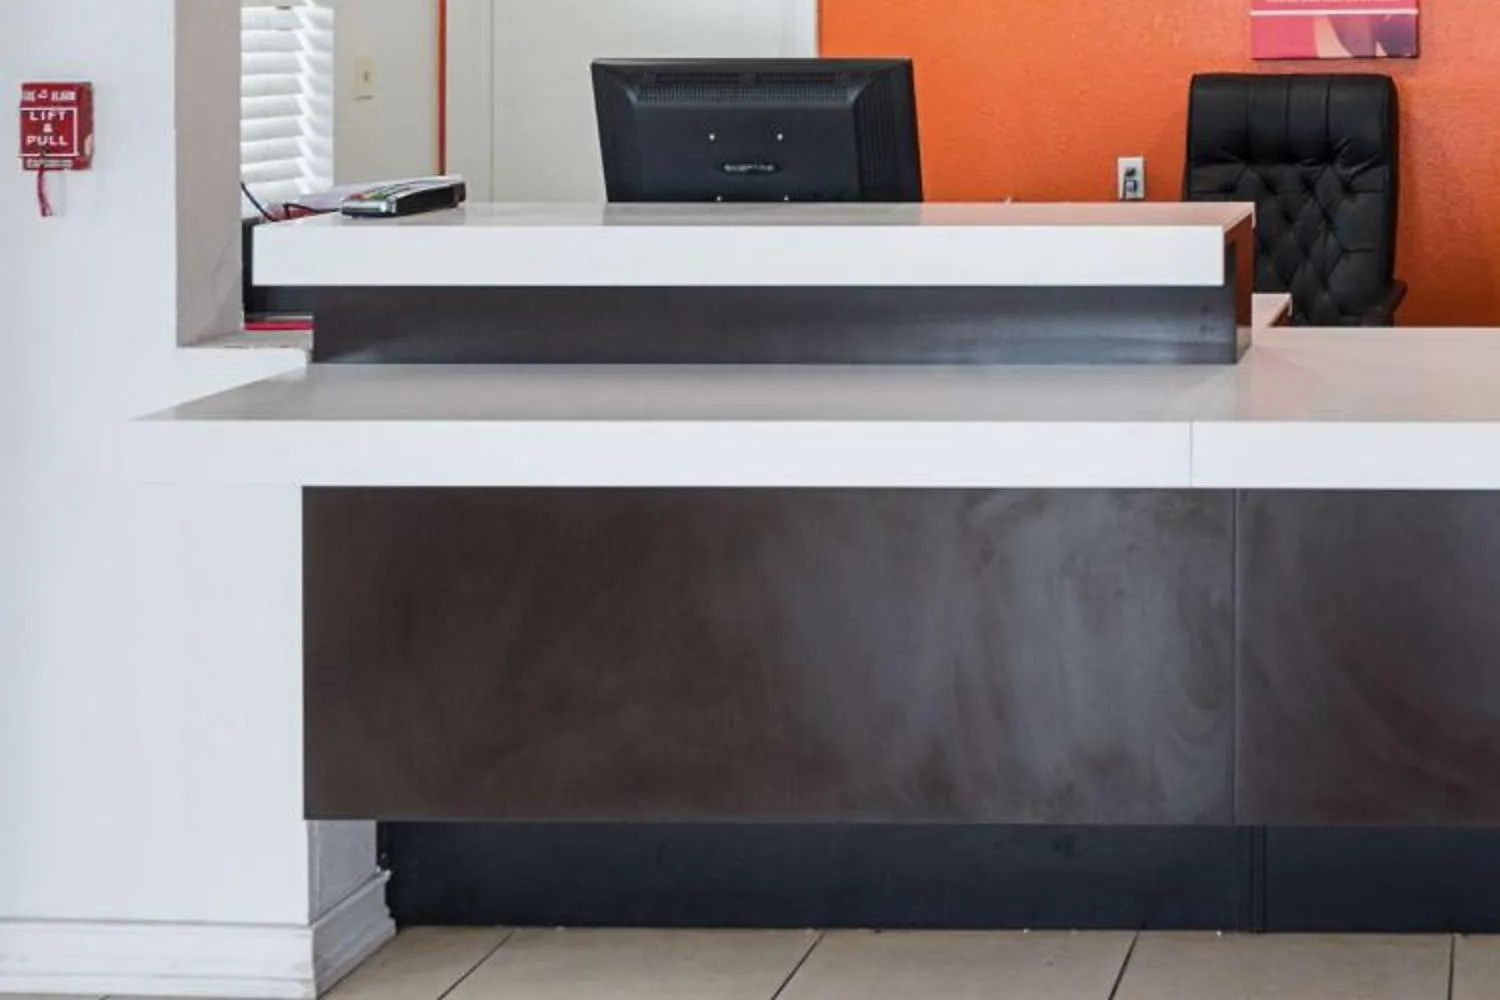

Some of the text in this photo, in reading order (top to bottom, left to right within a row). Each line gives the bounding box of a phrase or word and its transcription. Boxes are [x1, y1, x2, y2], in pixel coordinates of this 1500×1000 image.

[29, 111, 66, 121] LIFT
[43, 123, 53, 133] &
[27, 135, 68, 146] PULL
